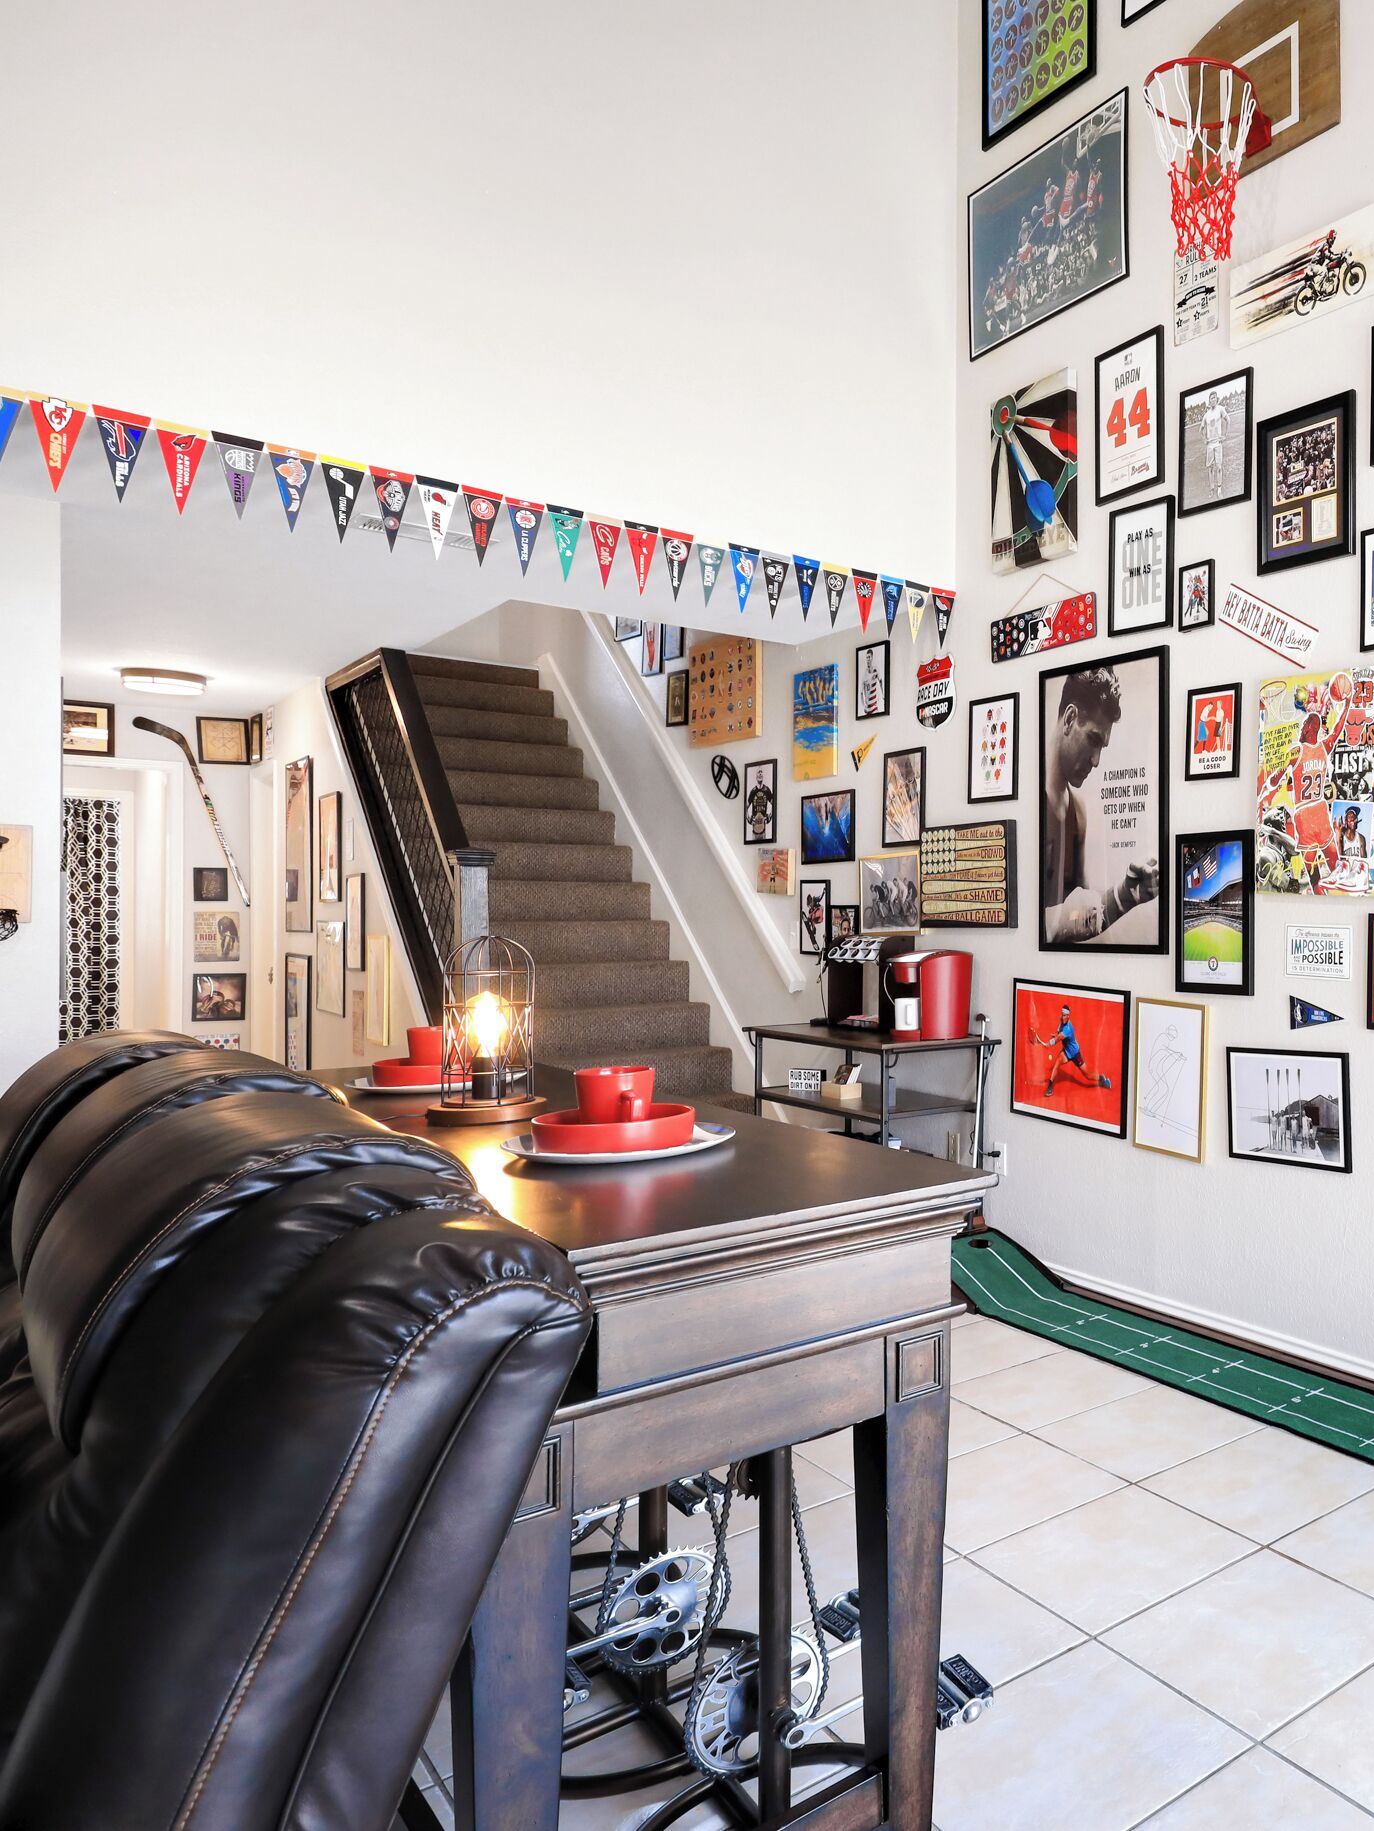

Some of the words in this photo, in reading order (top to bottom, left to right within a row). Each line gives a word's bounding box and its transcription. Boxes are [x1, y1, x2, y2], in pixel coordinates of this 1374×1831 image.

[1180, 274, 1188, 285] 27
[1199, 265, 1217, 279] TEAMS
[1114, 366, 1140, 392] AARON
[1106, 387, 1150, 448] 44
[49, 433, 62, 469] CHIEFS
[432, 511, 443, 536] HEAT
[1127, 532, 1143, 543] PLAY
[1144, 527, 1154, 538] AS
[1122, 531, 1163, 574] ONE
[1128, 566, 1141, 578] WIN
[1142, 564, 1151, 575] AS
[1122, 568, 1162, 610] ONE
[1223, 591, 1242, 620] HEY
[1237, 598, 1263, 634] BATTA
[1260, 612, 1288, 647] BATTA
[1285, 629, 1312, 652] Swing
[933, 681, 949, 698] DAY
[1353, 681, 1374, 704] 23
[924, 702, 948, 717] NASCAR
[1302, 760, 1326, 773] JORDAN
[1335, 752, 1363, 773] LAST
[1109, 768, 1138, 781] CHAMPION
[1140, 767, 1145, 777] IS
[1101, 786, 1131, 799] SOMEONE
[1133, 784, 1149, 796] WHO
[1301, 773, 1322, 800] 23
[1104, 804, 1117, 814] GETS
[1119, 803, 1126, 814] UP
[1128, 802, 1145, 813] WHEN
[1112, 819, 1118, 829] HE
[1120, 818, 1136, 829] CAN'T
[970, 830, 979, 838] ME
[981, 848, 1003, 859] CROWD
[969, 890, 1003, 900] SHAME!
[1292, 939, 1344, 955] IMPOSSIBLE
[1302, 951, 1343, 965] POSSIBLE
[790, 1071, 802, 1080] RUB
[803, 1072, 819, 1081] SOME
